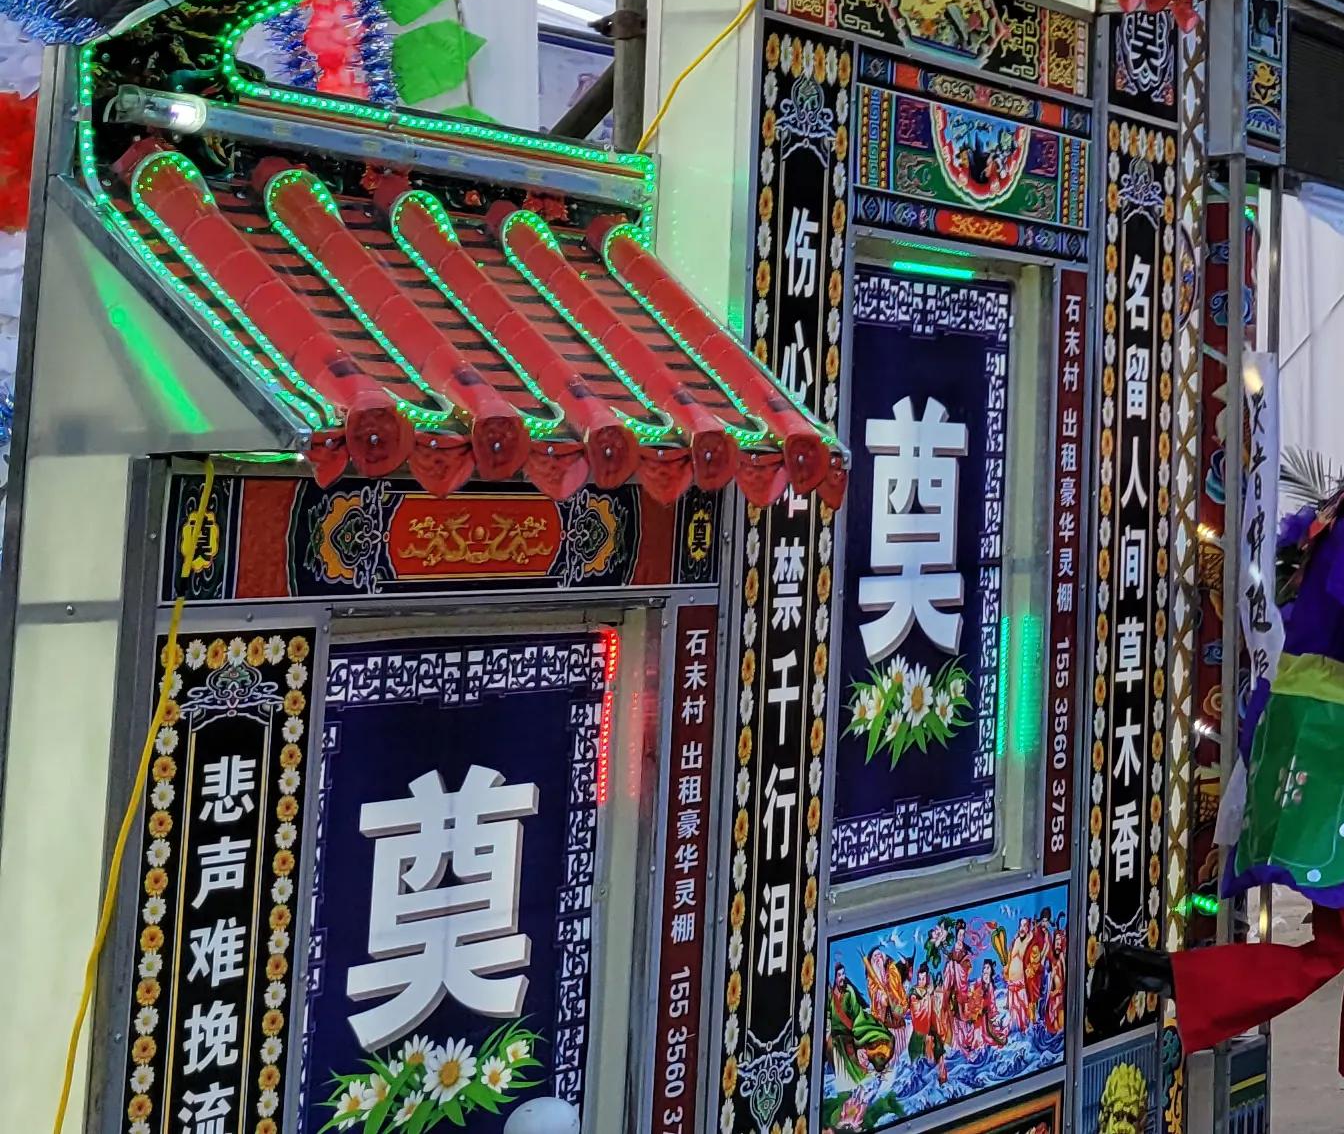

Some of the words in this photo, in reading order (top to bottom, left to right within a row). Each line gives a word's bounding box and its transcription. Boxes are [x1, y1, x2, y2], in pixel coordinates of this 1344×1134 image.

[859, 396, 969, 665] 奠
[1056, 407, 1080, 614] 出租豪华灵棚
[1110, 254, 1151, 884] 名留人间草木香
[681, 629, 710, 726] 石末村
[178, 754, 257, 1134] 悲声难挽流
[346, 763, 540, 1053] 奠
[671, 740, 704, 944] 出租豪华灵棚
[664, 1026, 689, 1099] 3560
[668, 965, 691, 1020] 155
